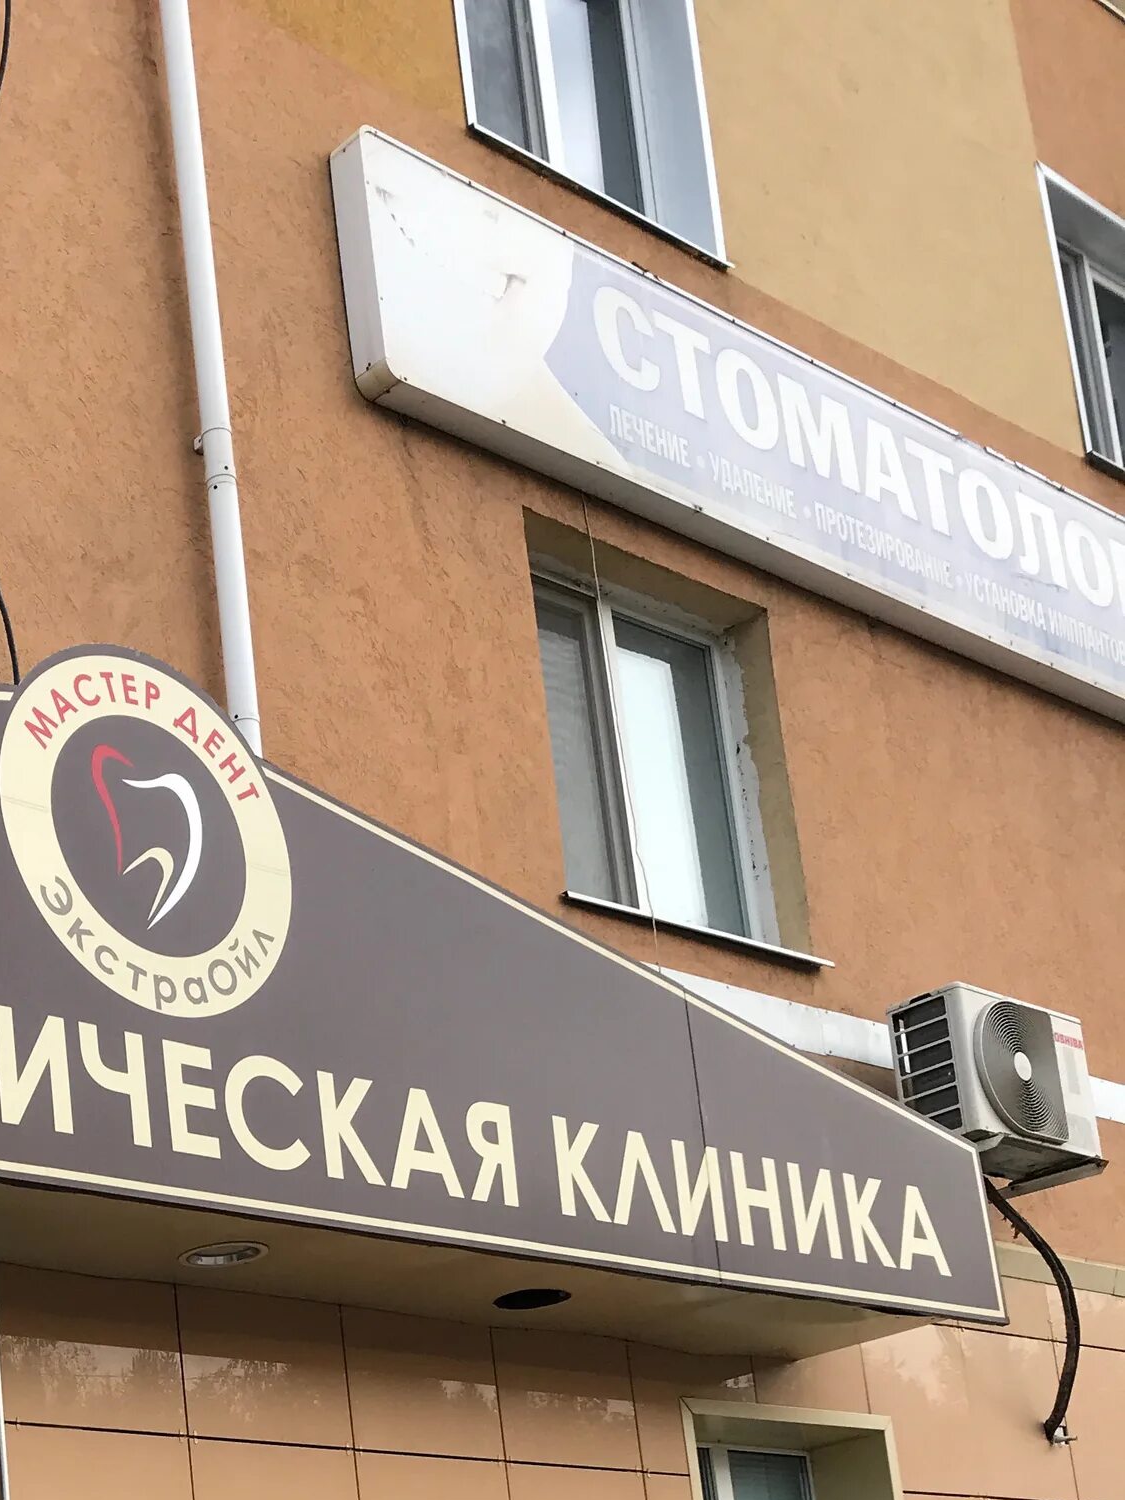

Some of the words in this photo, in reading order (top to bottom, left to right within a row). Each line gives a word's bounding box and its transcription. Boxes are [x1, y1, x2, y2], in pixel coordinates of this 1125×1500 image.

[609, 403, 692, 468] ЛЕЧЕНИЕ
[707, 451, 797, 519] УДАЛЕНИЕ
[814, 501, 954, 589] ПРОТЕЗИРОВАНИЕ
[964, 570, 1047, 633] УСТАНОВКА
[23, 670, 161, 750] МАСТЕР
[173, 706, 260, 802] ДЕНТ
[39, 874, 275, 1010] ЭкстраОйл
[552, 1115, 952, 1277] КЛИНИКА
